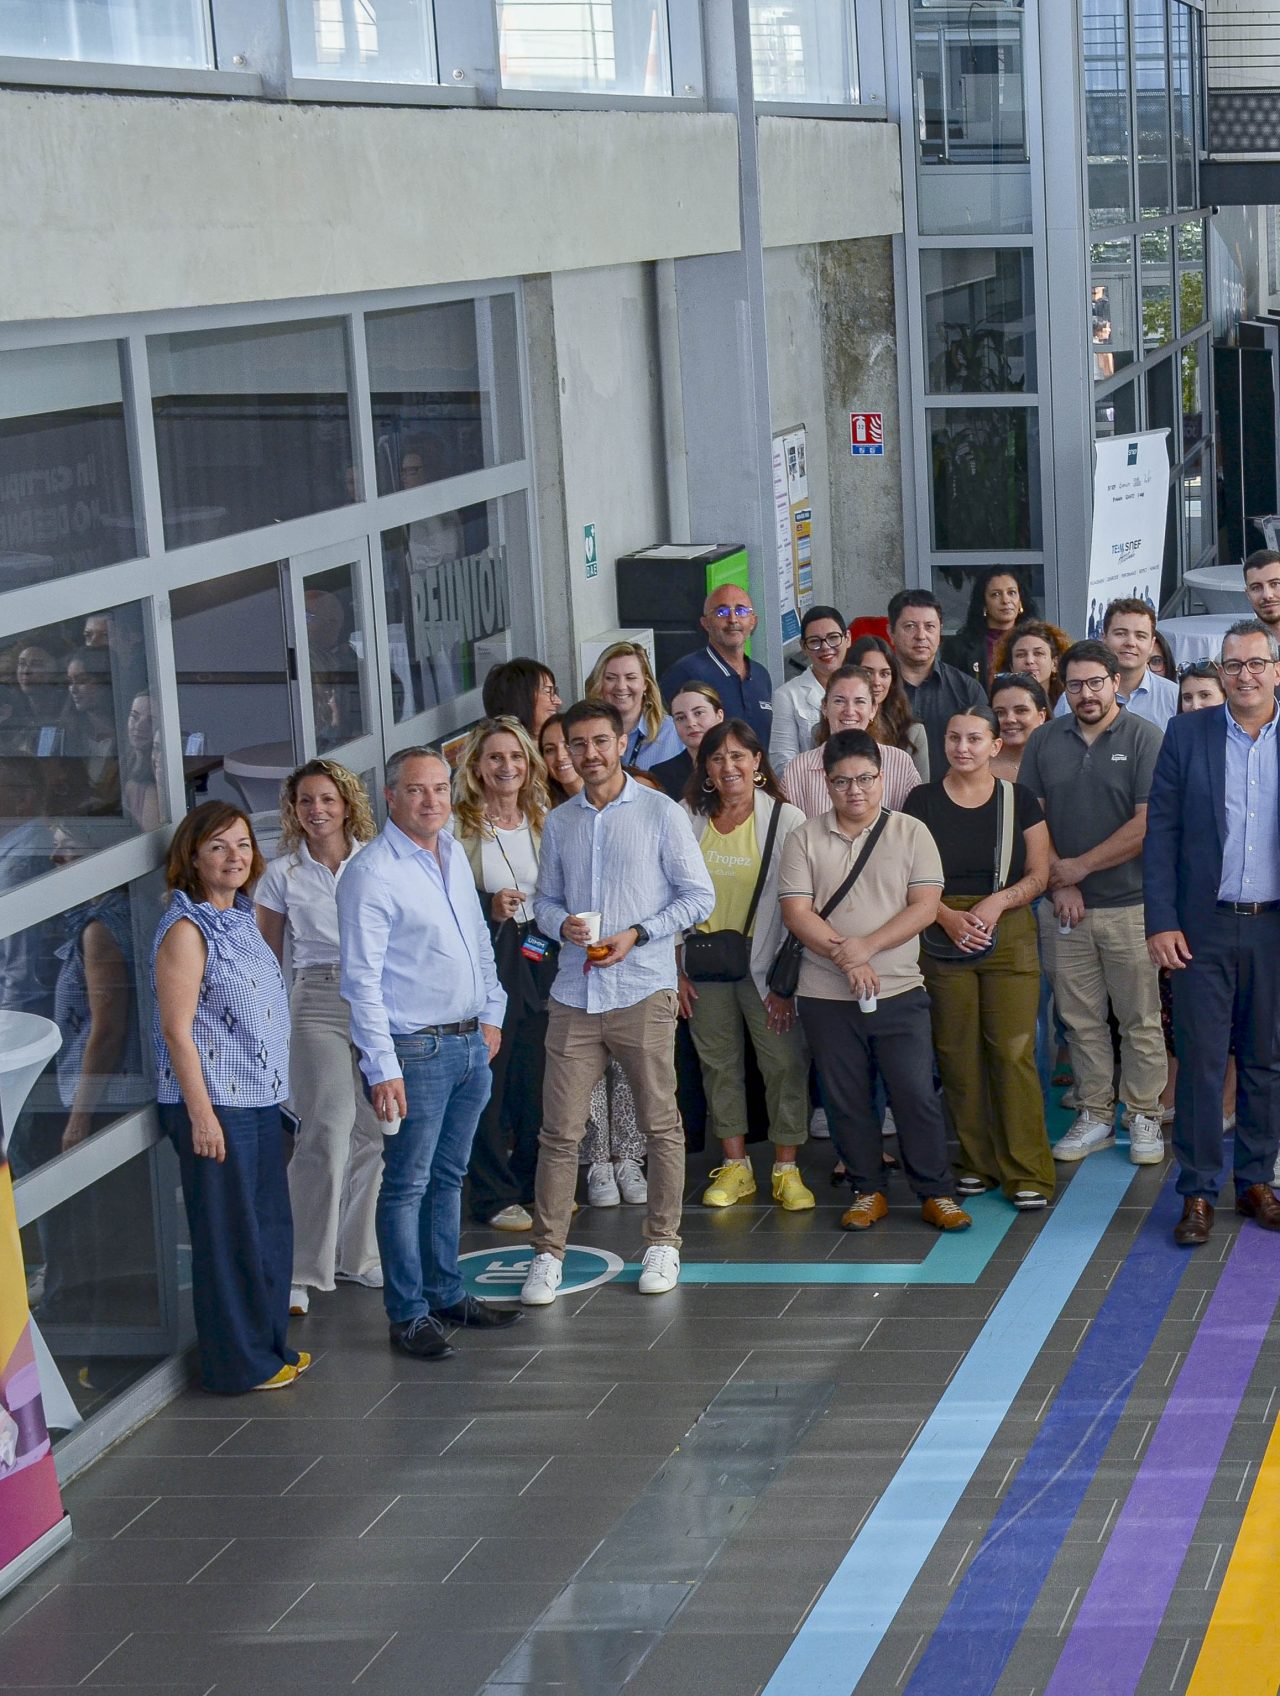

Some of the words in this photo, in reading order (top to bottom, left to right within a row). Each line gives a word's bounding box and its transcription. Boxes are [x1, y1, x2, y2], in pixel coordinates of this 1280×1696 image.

[586, 563, 598, 578] DAE
[706, 850, 752, 867] Tropez
[527, 937, 546, 949] UIMM
